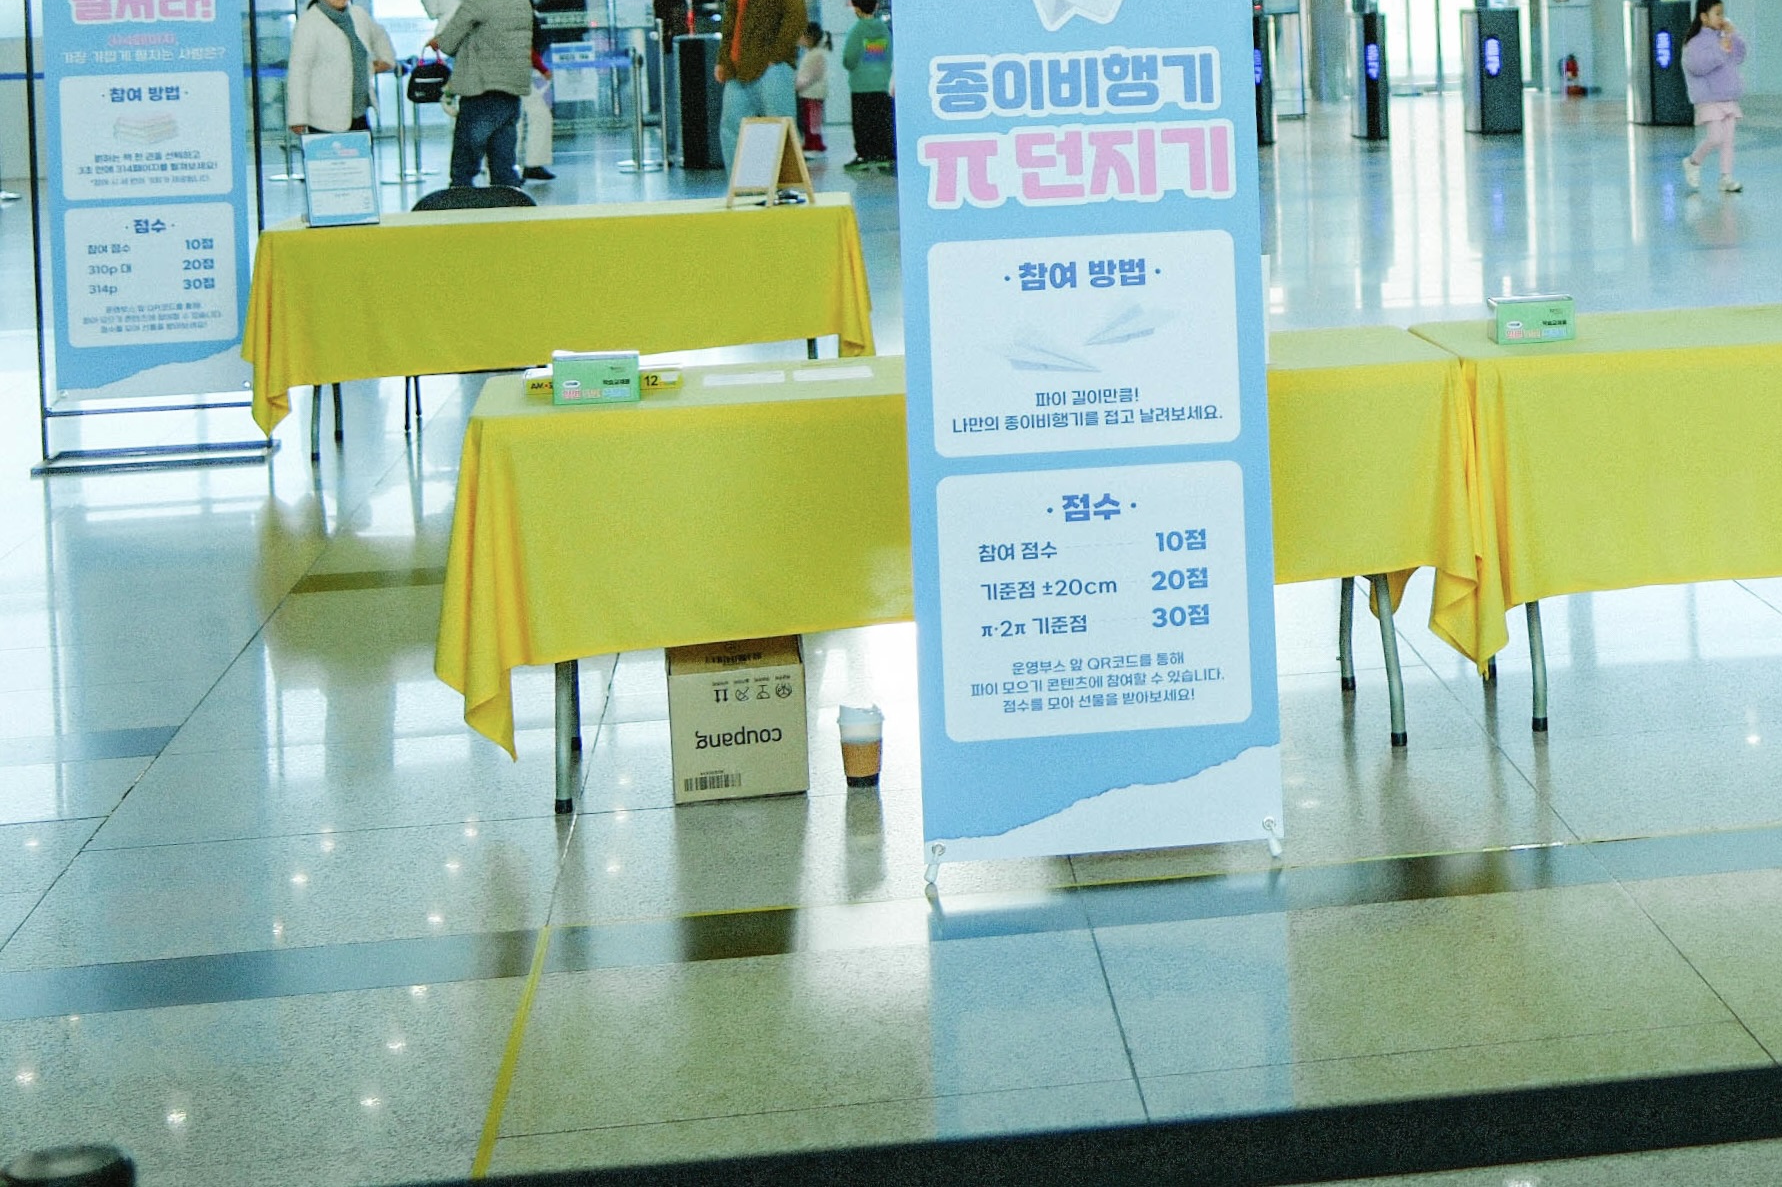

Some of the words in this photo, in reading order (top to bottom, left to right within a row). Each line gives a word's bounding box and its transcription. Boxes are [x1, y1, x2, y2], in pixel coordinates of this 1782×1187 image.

[110, 87, 142, 103] 참여
[148, 86, 180, 102] 방법
[935, 52, 1214, 114] 종이비행기
[923, 138, 1000, 203] π
[1015, 125, 1231, 200] 던지기
[133, 218, 167, 234] 점수
[87, 244, 108, 255] 참여
[111, 243, 131, 254] 점수
[185, 238, 214, 250] 10점
[88, 264, 118, 276] 310p
[120, 263, 132, 274] 대
[183, 258, 215, 271] 20점
[1018, 261, 1078, 291] 참여
[1088, 258, 1147, 289] 방법
[88, 285, 118, 296] 314p
[183, 277, 215, 290] 30점
[644, 375, 658, 387] 12
[1035, 391, 1067, 407] 파이
[1071, 387, 1139, 406] 길이만큼!
[952, 416, 1000, 434] 나만의
[1004, 411, 1099, 431] 종이비행기를
[1103, 409, 1135, 426] 접고
[1139, 404, 1224, 424] 날려보세요.
[1061, 493, 1121, 523] 점수
[978, 543, 1015, 563] 참여
[1020, 541, 1058, 560] 점수
[1155, 528, 1207, 552] 10점
[980, 580, 1036, 601] 기준점
[1041, 578, 1118, 597] ±20cm
[1150, 566, 1209, 592] 20점
[1031, 614, 1087, 635] 기준점
[1151, 603, 1210, 628] 30점
[1011, 659, 1066, 676] 운영부스
[1069, 657, 1083, 672] 앞
[1086, 653, 1152, 671] QR코드를
[1156, 651, 1185, 666] 통해
[970, 682, 998, 697] 파이
[1002, 679, 1043, 695] 모으기
[1047, 676, 1103, 692] 콘텐츠에
[1106, 672, 1147, 688] 참여할
[1150, 672, 1164, 685] 수
[1167, 667, 1225, 683] 있습니다.
[1002, 697, 1043, 713] 점수를
[1047, 696, 1074, 710] 모아
[1078, 692, 1119, 708] 선물을
[1122, 688, 1196, 705] 받아보세요!
[694, 725, 782, 750] coupang
